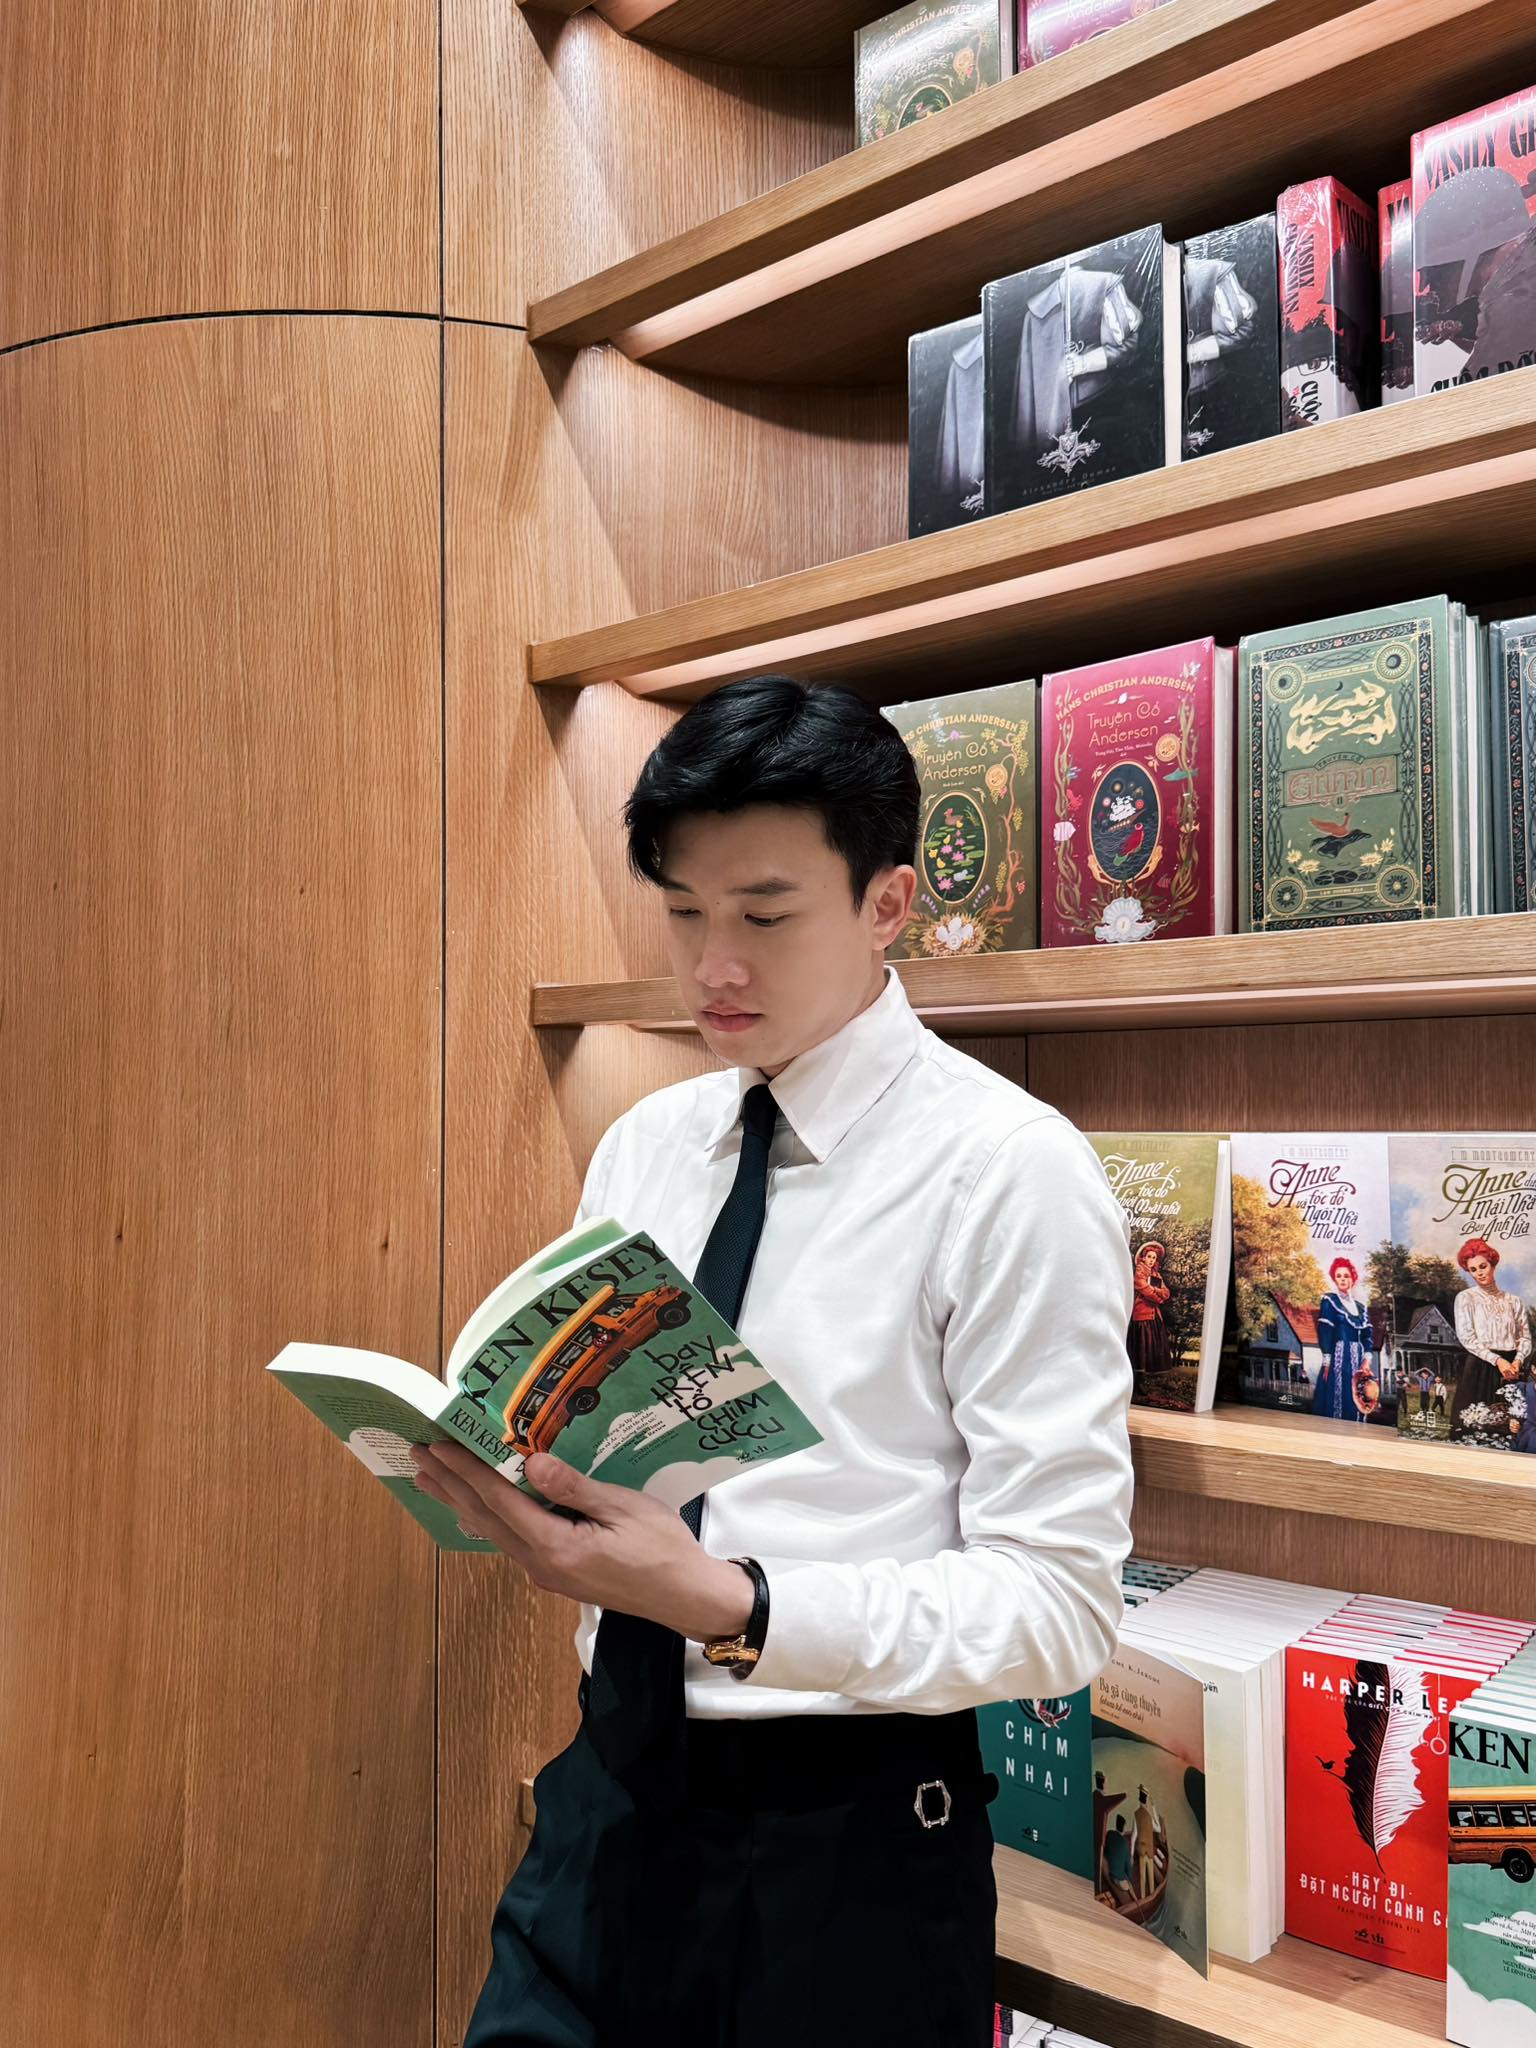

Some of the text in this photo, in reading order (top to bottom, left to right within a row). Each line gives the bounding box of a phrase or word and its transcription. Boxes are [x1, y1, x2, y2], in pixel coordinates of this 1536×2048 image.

[1299, 233, 1315, 288] VASILY
[1055, 676, 1196, 721] HANS CHRISTIAN ANDERSEN
[916, 714, 967, 735] CHRISTIAN
[968, 713, 1018, 732] ANDERSEN
[1088, 725, 1159, 748] Andersen
[922, 764, 987, 781] Andersen
[1289, 766, 1388, 802] Grimm
[1102, 1152, 1176, 1197] Anne
[1473, 1150, 1535, 1162] MONTGOMERY
[1268, 1159, 1357, 1209] Anne
[1432, 1164, 1536, 1222] Anne
[458, 1240, 668, 1415] KEN KESEY
[449, 1408, 480, 1436] KEN
[476, 1429, 517, 1463] KESEY
[1302, 1671, 1404, 1706] HARPER
[1005, 1720, 1068, 1759] CHIM
[1449, 1721, 1532, 1775] KEN
[1005, 1756, 1068, 1797] NHẠI
[1299, 1873, 1326, 1894] ĐẶT
[1332, 1883, 1377, 1910] NGƯỜI
[1384, 1897, 1424, 1923] CANH
[1352, 1871, 1405, 1899] HÃY ĐI
